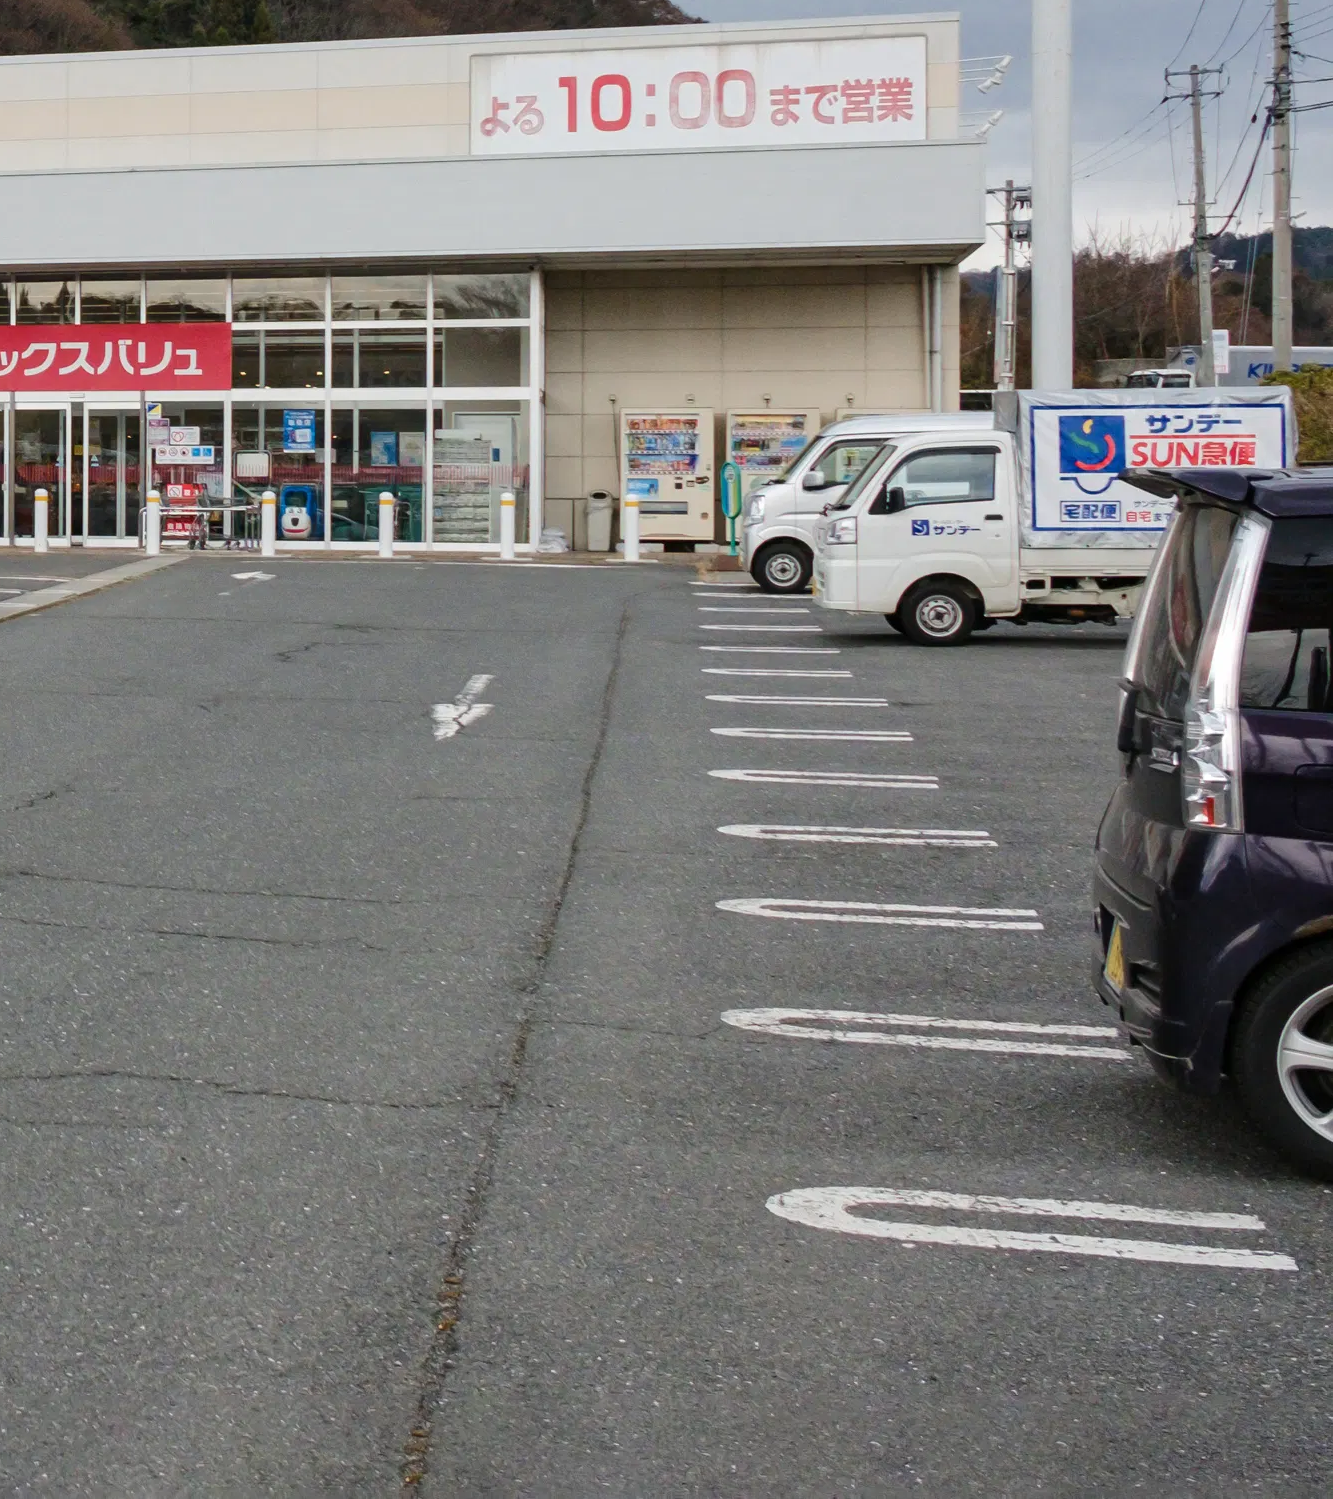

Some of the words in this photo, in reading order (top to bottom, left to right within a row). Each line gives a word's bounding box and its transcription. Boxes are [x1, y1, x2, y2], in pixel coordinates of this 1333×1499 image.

[1145, 414, 1243, 434] サンデー
[1130, 441, 1257, 467] SUN急便
[1063, 503, 1118, 520] 宅配便
[933, 525, 982, 535] サンデー
